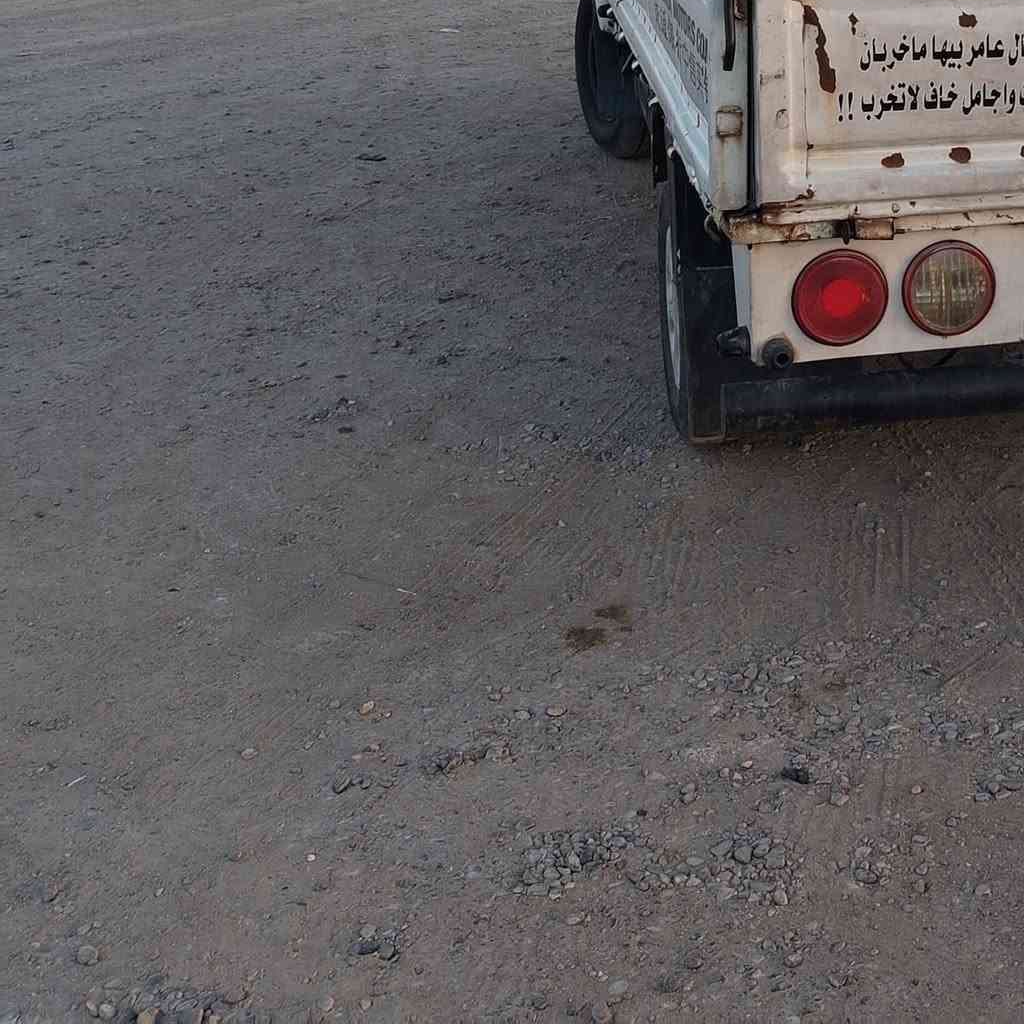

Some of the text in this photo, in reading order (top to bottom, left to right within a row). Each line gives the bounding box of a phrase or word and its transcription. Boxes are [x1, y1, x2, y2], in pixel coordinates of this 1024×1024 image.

[932, 34, 962, 70] بيها
[966, 33, 1004, 66] عامر
[924, 81, 957, 110] خاف
